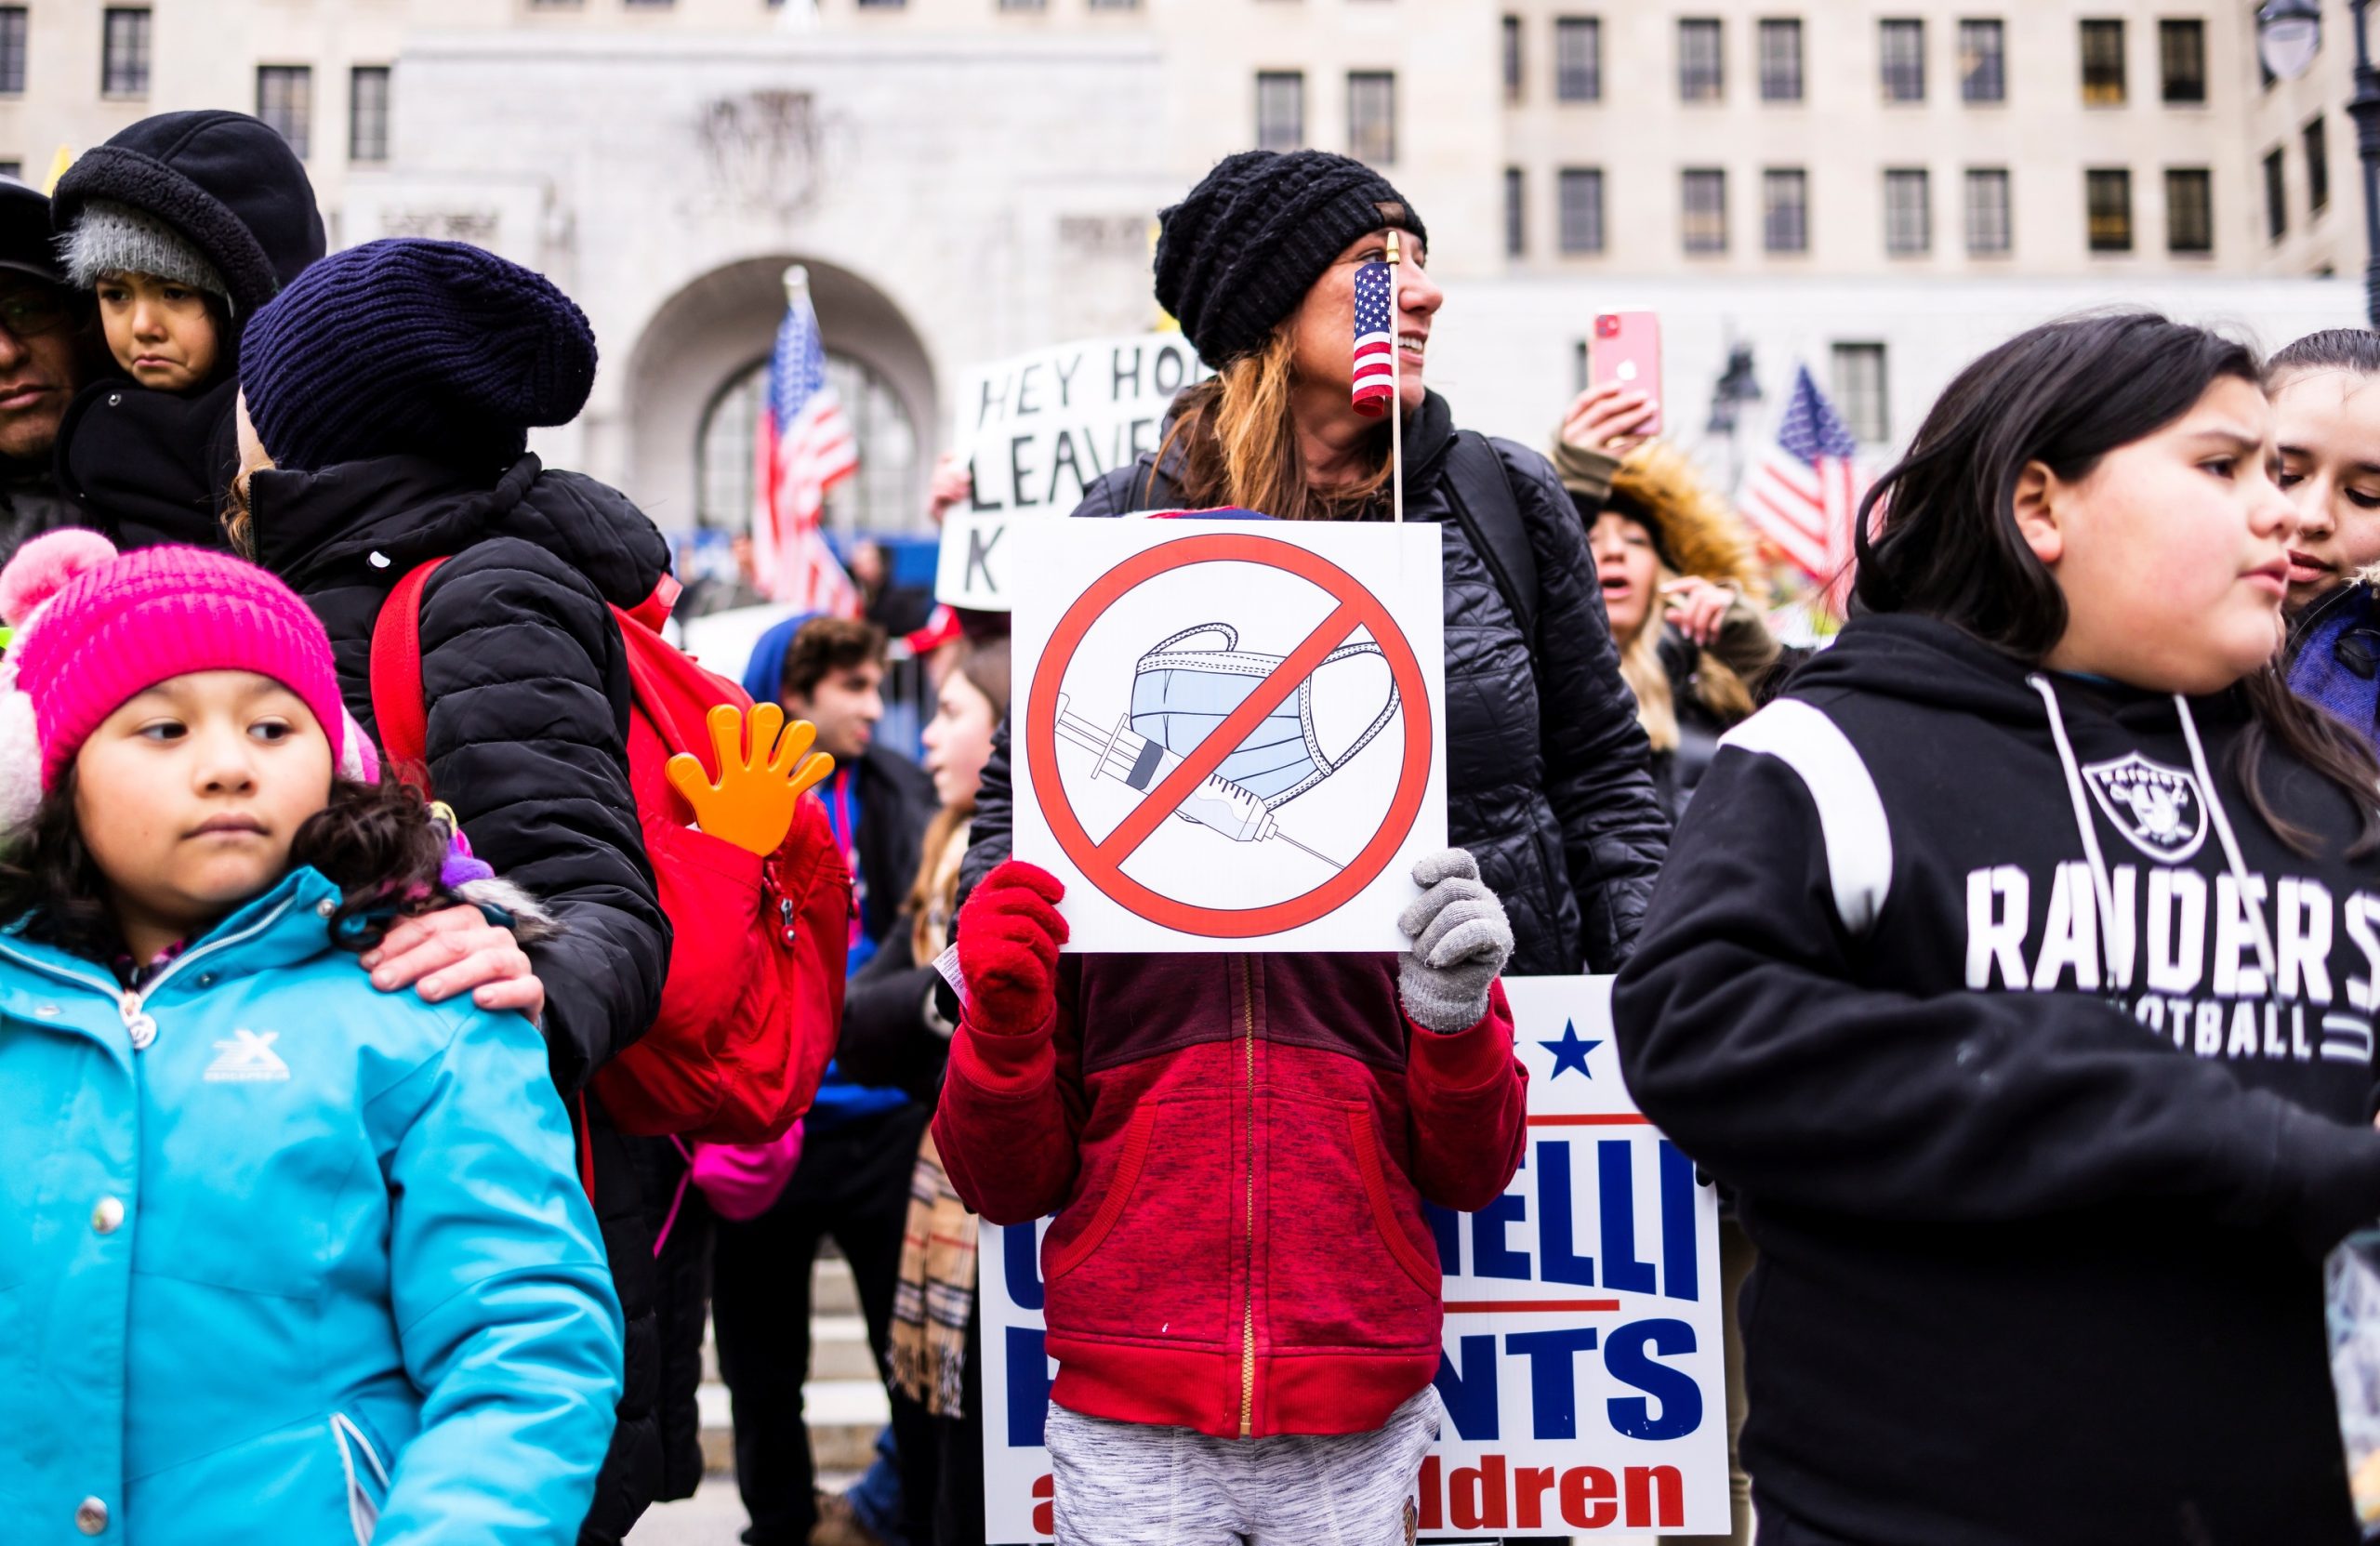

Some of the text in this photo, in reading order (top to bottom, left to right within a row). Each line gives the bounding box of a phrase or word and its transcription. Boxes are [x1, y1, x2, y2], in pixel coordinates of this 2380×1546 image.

[978, 345, 1199, 429] HEY HO
[968, 417, 1156, 512] LEAVE
[1964, 859, 2380, 1014] RAIDERS
